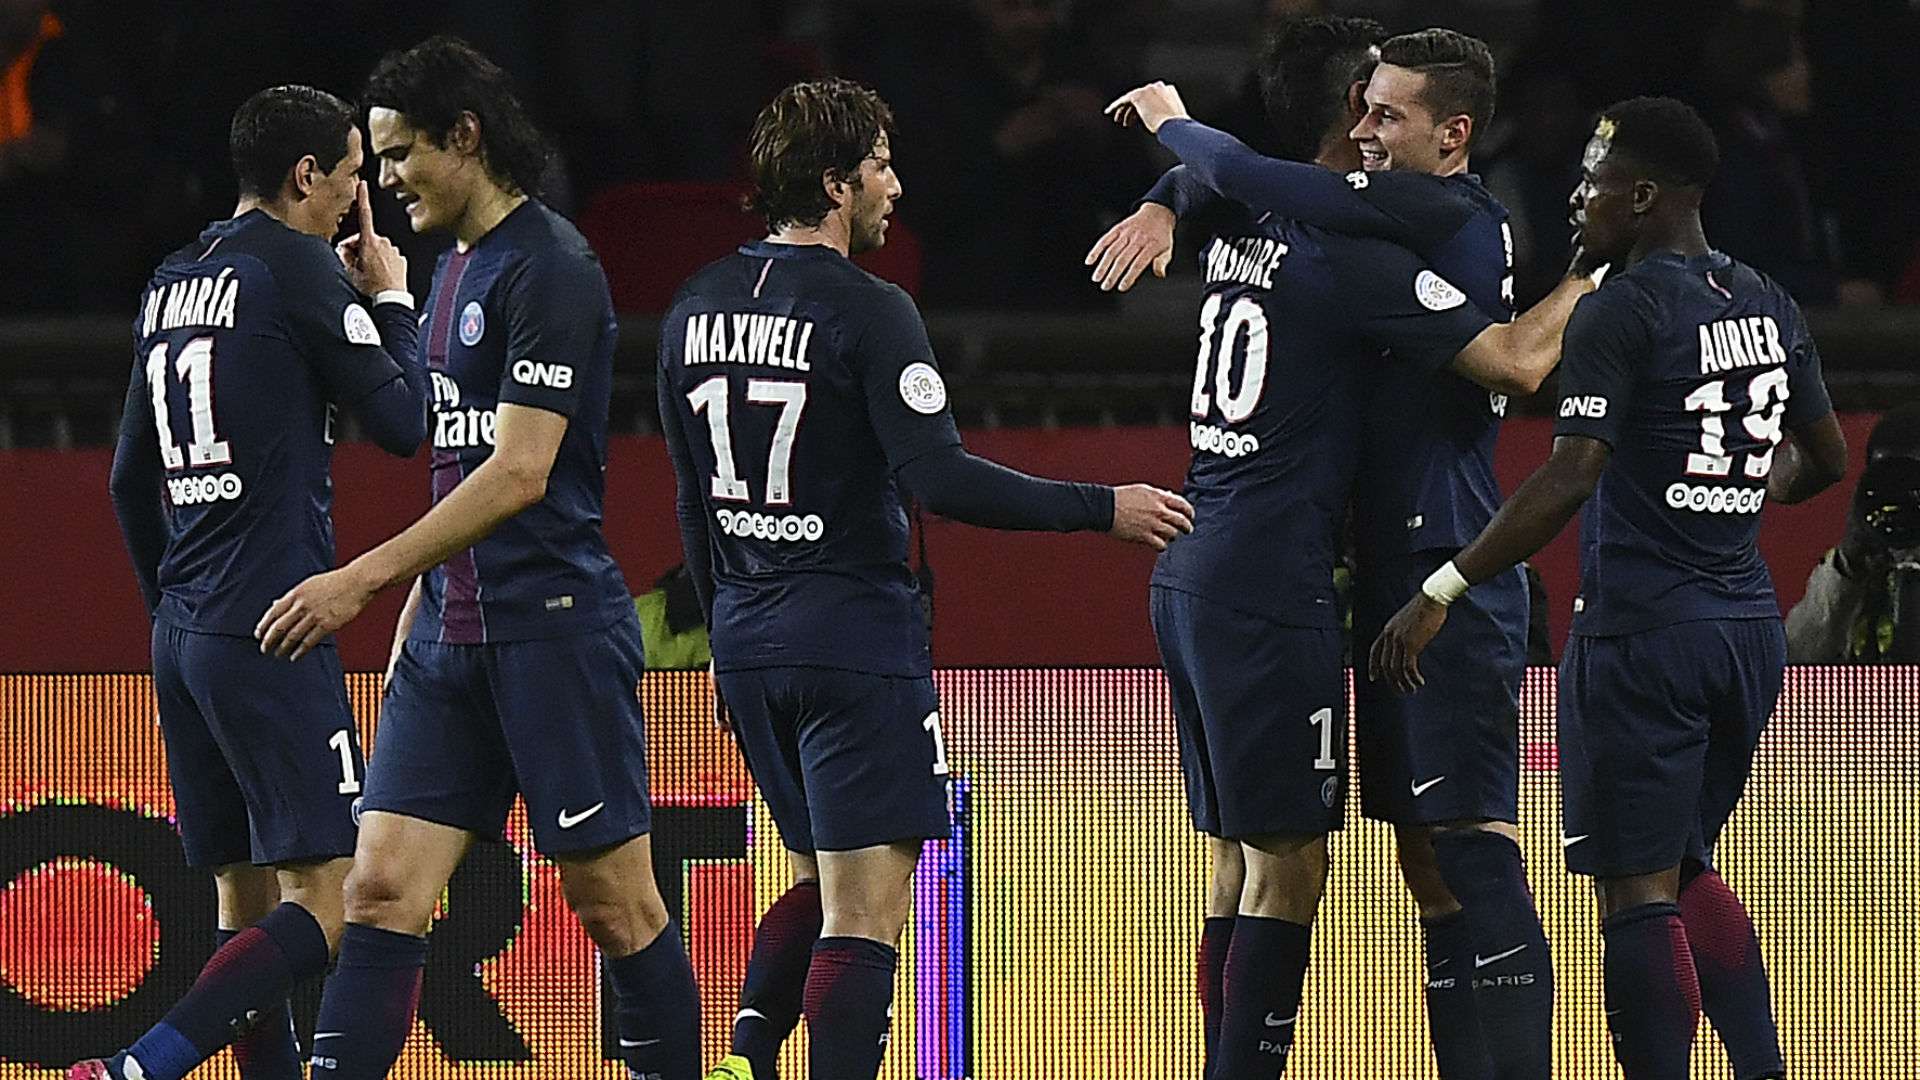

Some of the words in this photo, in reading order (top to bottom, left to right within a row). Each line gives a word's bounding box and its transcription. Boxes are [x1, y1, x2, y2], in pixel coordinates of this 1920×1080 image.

[161, 267, 239, 329] MARÍA
[684, 313, 814, 371] MAXWELL
[1190, 292, 1270, 424] 10
[1699, 316, 1787, 374] AURIER
[146, 336, 232, 470] 11
[512, 360, 573, 389] QNB
[1559, 396, 1607, 418] QNB
[1684, 366, 1790, 479] 19
[686, 374, 807, 504] 17
[923, 711, 949, 775] 1
[1309, 707, 1336, 770] 1
